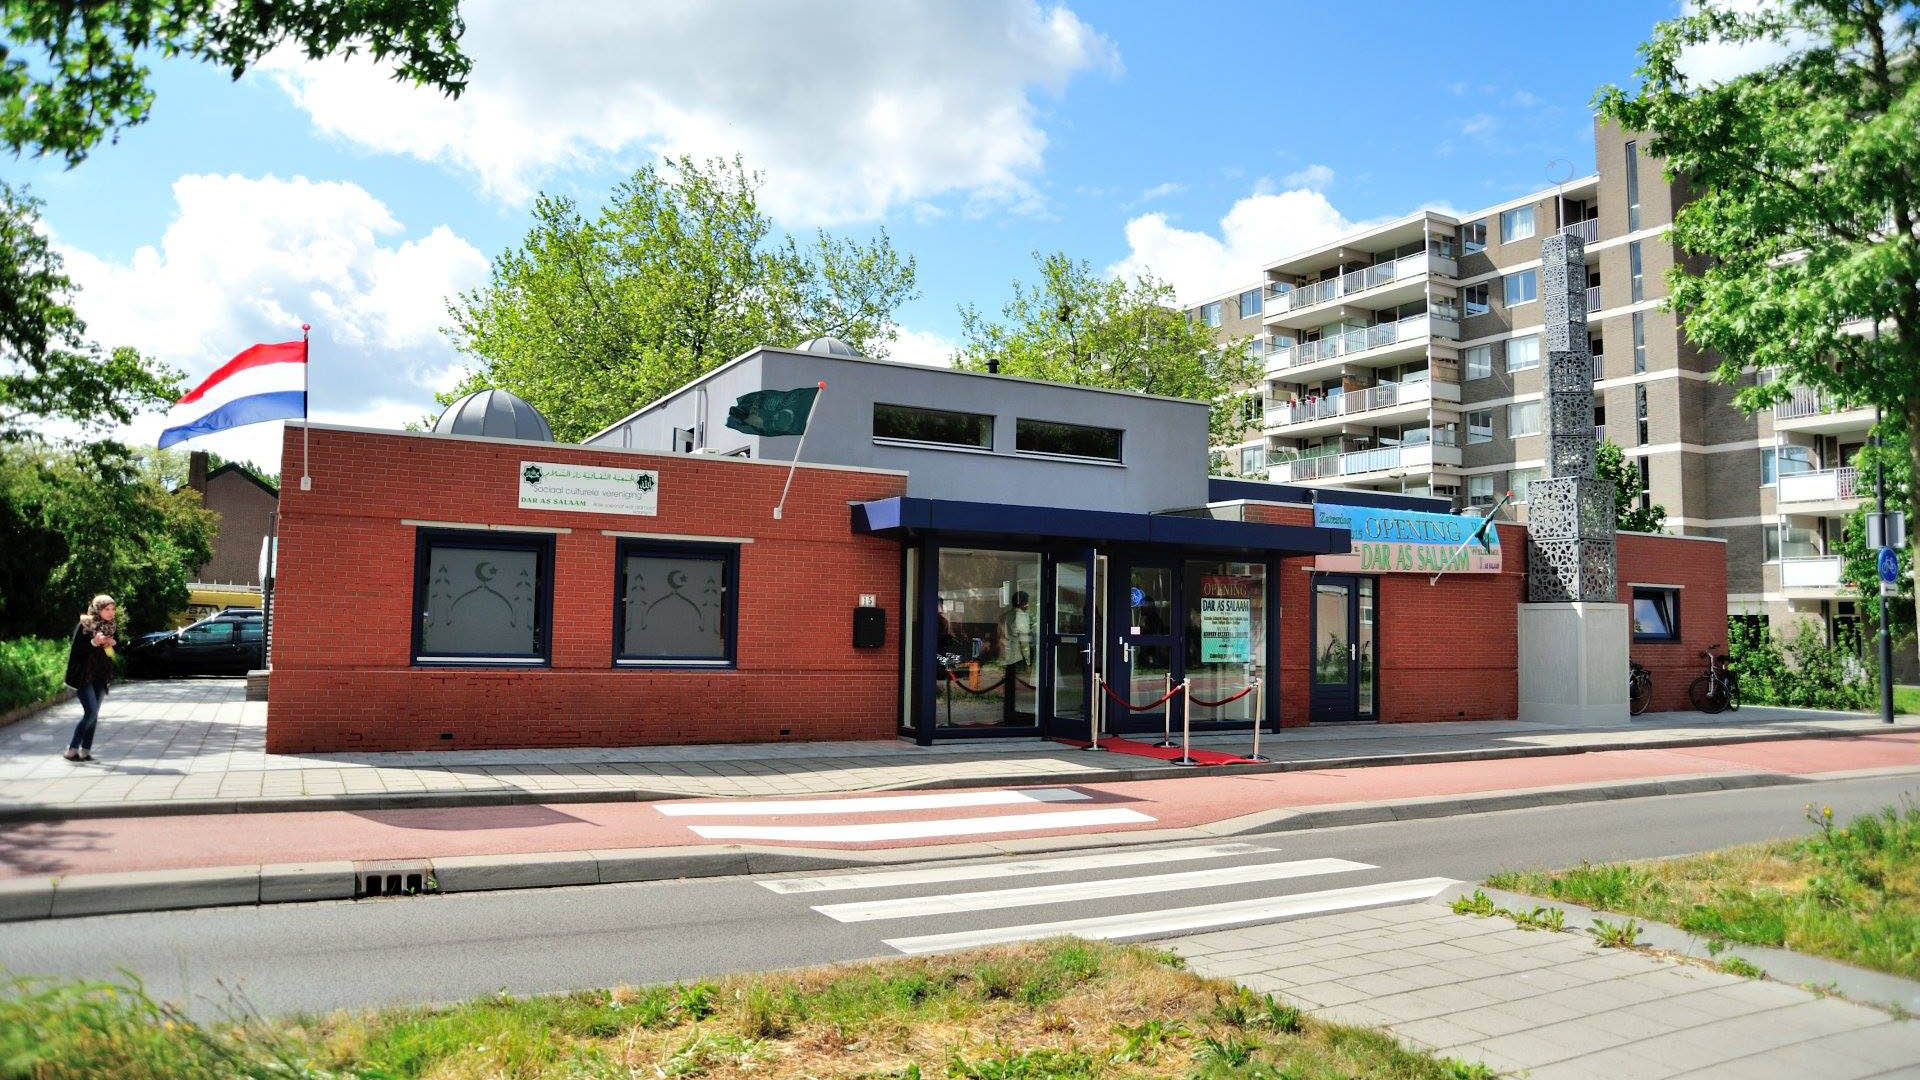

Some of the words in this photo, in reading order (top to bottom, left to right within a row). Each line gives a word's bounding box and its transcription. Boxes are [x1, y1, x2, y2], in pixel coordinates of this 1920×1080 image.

[533, 484, 564, 495] Sociaal
[521, 496, 538, 504] DAR
[540, 497, 551, 505] AS
[553, 498, 586, 507] SALAAM
[1365, 517, 1461, 542] OPENING
[1361, 543, 1392, 570] DAR
[1396, 544, 1414, 570] AS
[1417, 545, 1469, 570] SALAAM
[1204, 583, 1247, 595] OPENING
[863, 596, 873, 606] 15
[1203, 600, 1215, 611] DAR
[1217, 600, 1225, 611] AS
[1226, 600, 1248, 611] SALAAM
